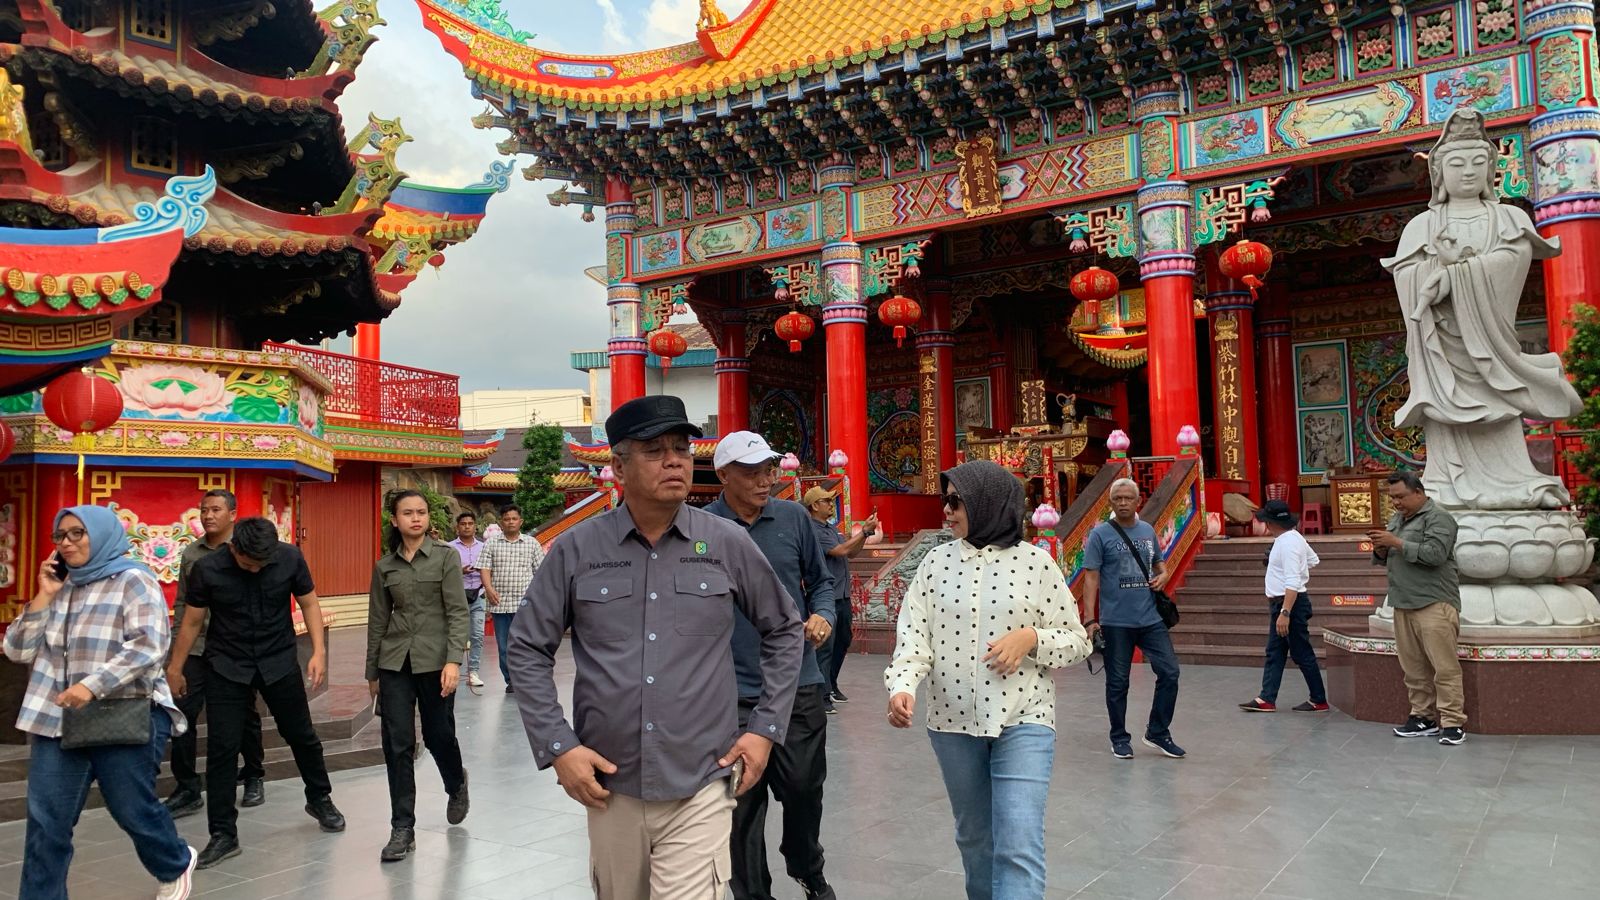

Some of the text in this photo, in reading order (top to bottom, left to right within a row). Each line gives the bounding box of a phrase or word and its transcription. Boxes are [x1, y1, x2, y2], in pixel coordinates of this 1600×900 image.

[971, 152, 989, 203] 觀音堂
[588, 560, 632, 570] HARISSON
[679, 556, 722, 566] GUBERNUR
